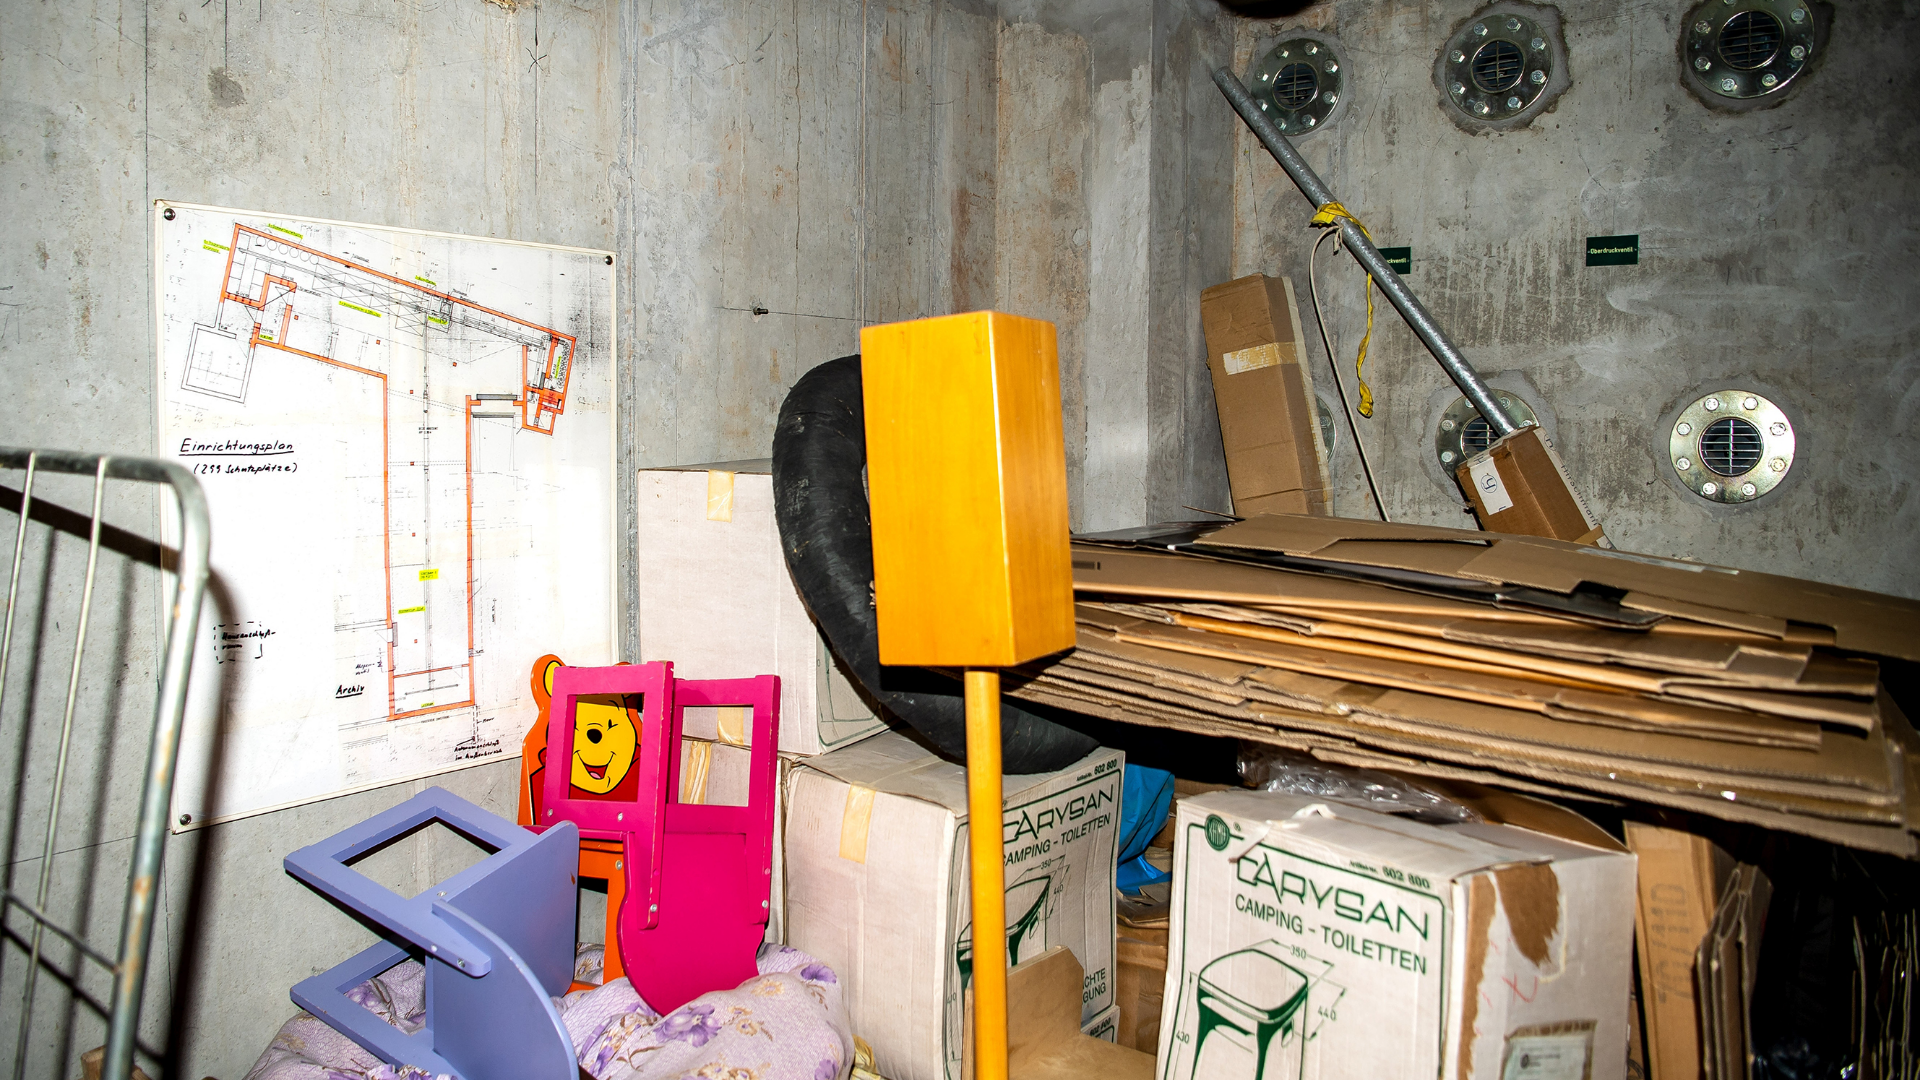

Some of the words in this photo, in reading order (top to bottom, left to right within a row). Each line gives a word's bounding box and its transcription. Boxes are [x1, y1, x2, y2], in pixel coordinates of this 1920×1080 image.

[180, 438, 293, 455] Einrichtungsplan
[335, 684, 365, 696] Archiv
[1107, 759, 1118, 770] 800
[1003, 839, 1051, 867] AMPING
[1061, 812, 1111, 845] TOILETTEN
[1041, 858, 1052, 870] 350
[1382, 866, 1404, 883] 602
[1408, 873, 1431, 890] 800
[1237, 852, 1429, 941] CARYSAN
[1235, 893, 1303, 935] CAMPING
[1320, 925, 1427, 975] TOILETTEN
[1290, 945, 1307, 960] 350
[1083, 967, 1106, 990] CHTE
[1317, 1005, 1337, 1022] 440
[1175, 1030, 1190, 1044] 430
